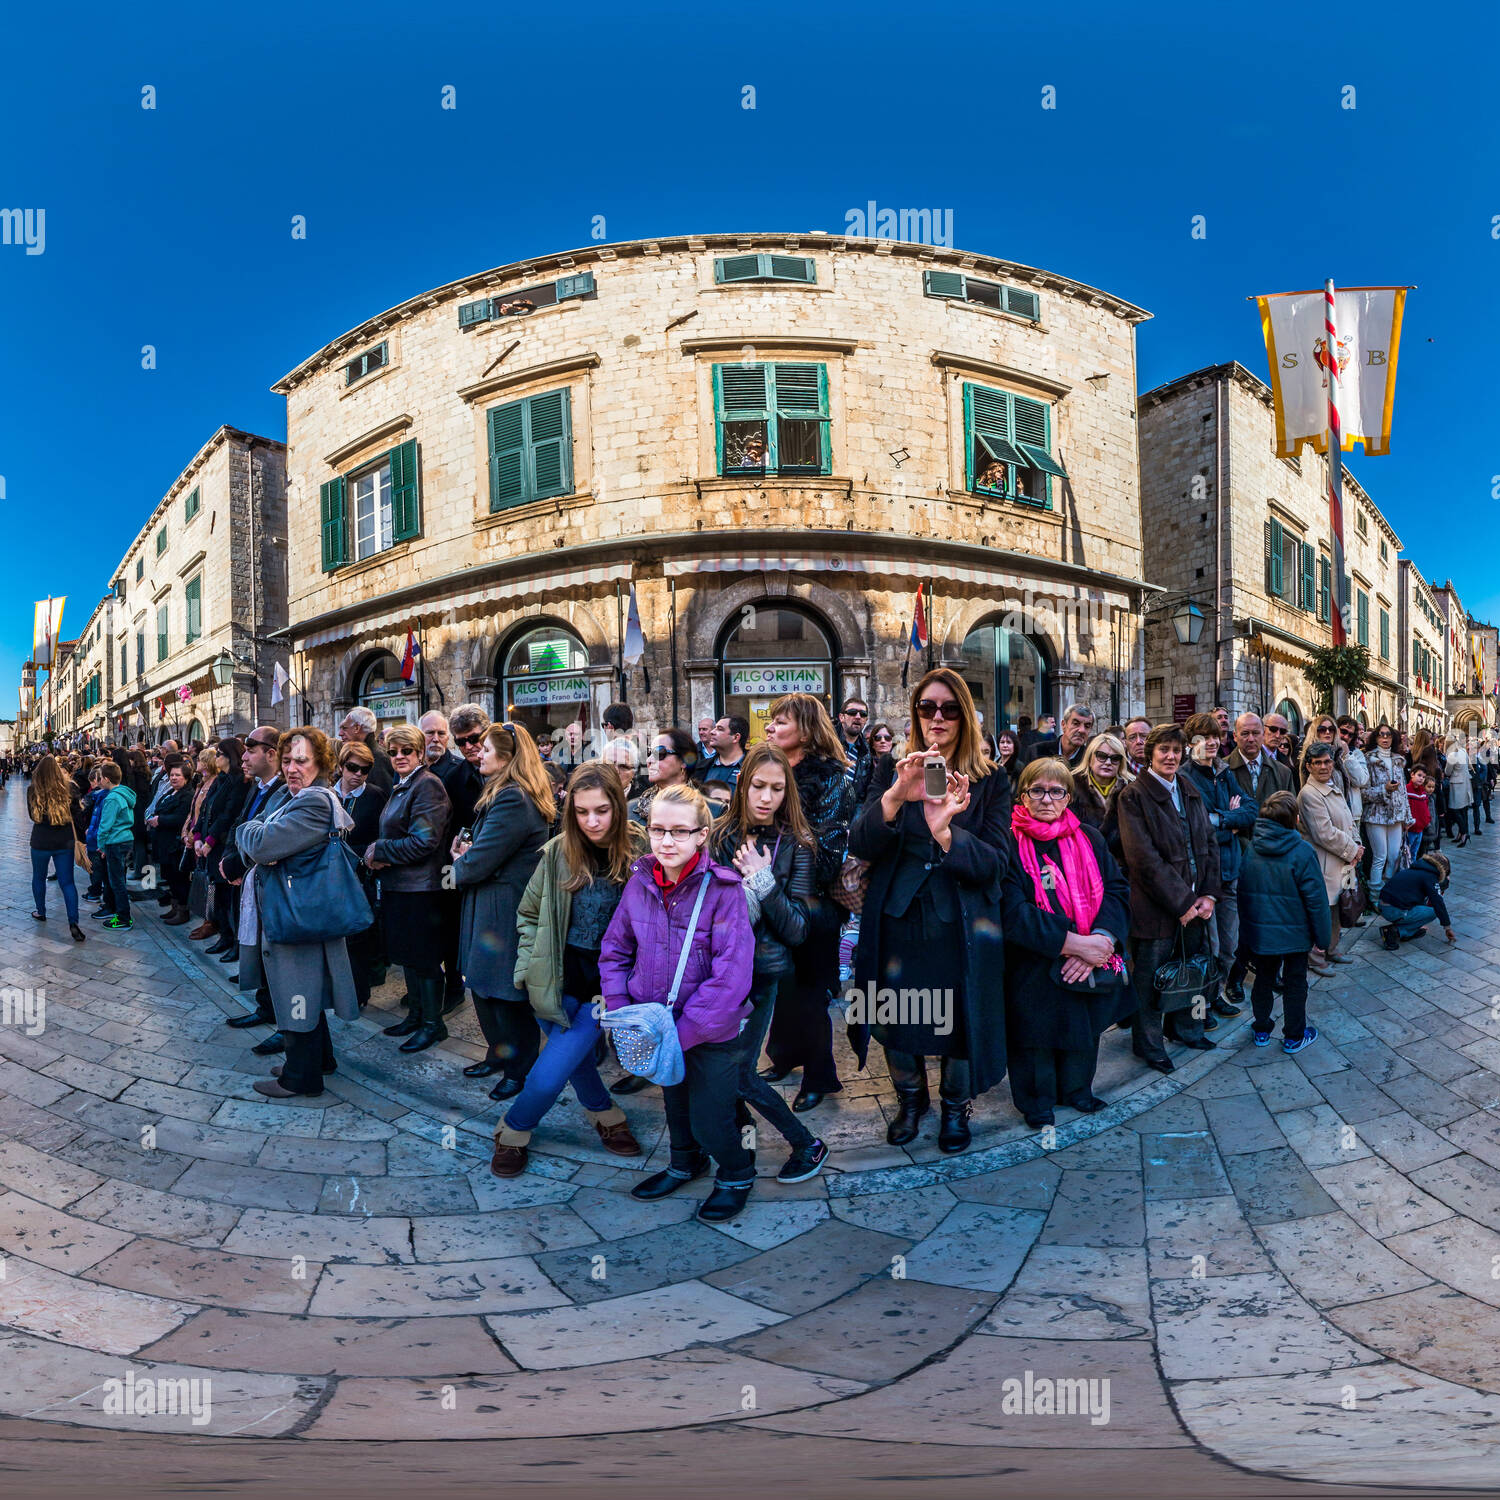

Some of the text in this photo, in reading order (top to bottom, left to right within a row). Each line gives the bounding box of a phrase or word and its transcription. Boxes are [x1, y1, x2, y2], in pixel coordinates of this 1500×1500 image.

[1282, 350, 1387, 369] S B
[733, 669, 823, 682] ALGORITAM
[515, 679, 588, 695] ALGORITAM
[733, 684, 823, 693] BOOKSHOP
[369, 697, 406, 711] ALGORITA
